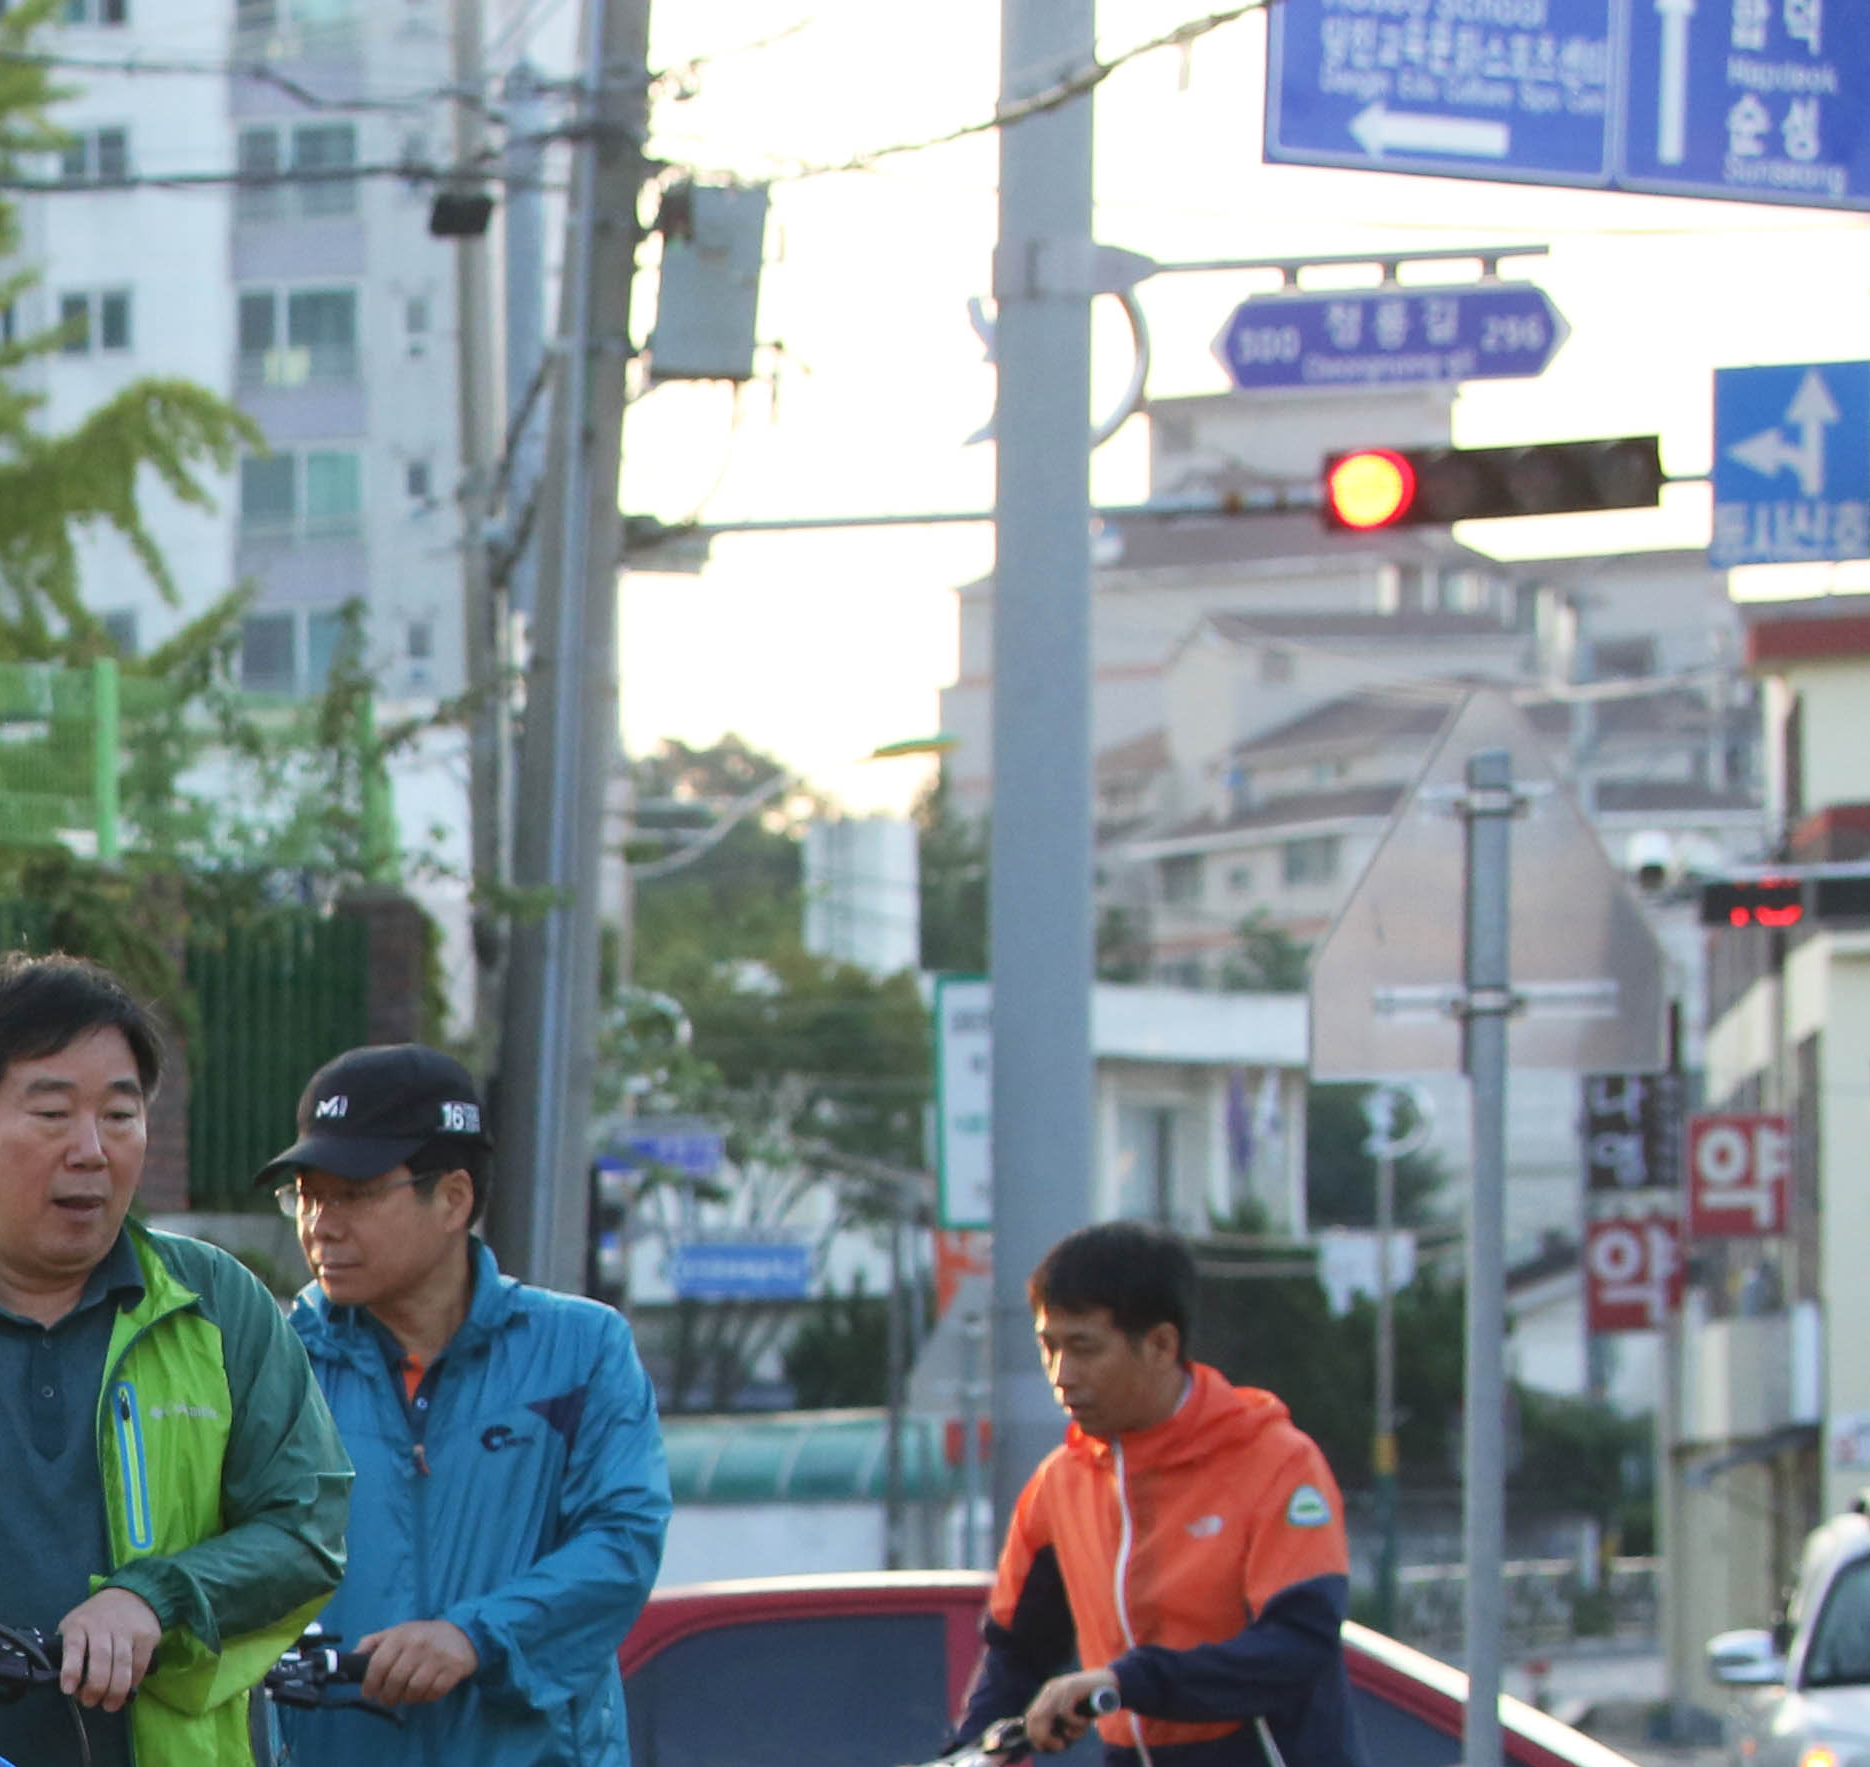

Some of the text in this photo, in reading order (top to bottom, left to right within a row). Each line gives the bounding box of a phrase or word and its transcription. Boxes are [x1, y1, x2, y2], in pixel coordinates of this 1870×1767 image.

[1726, 93, 1820, 160] 순성
[1697, 1125, 1792, 1230] 약
[1590, 1222, 1680, 1320] 약
